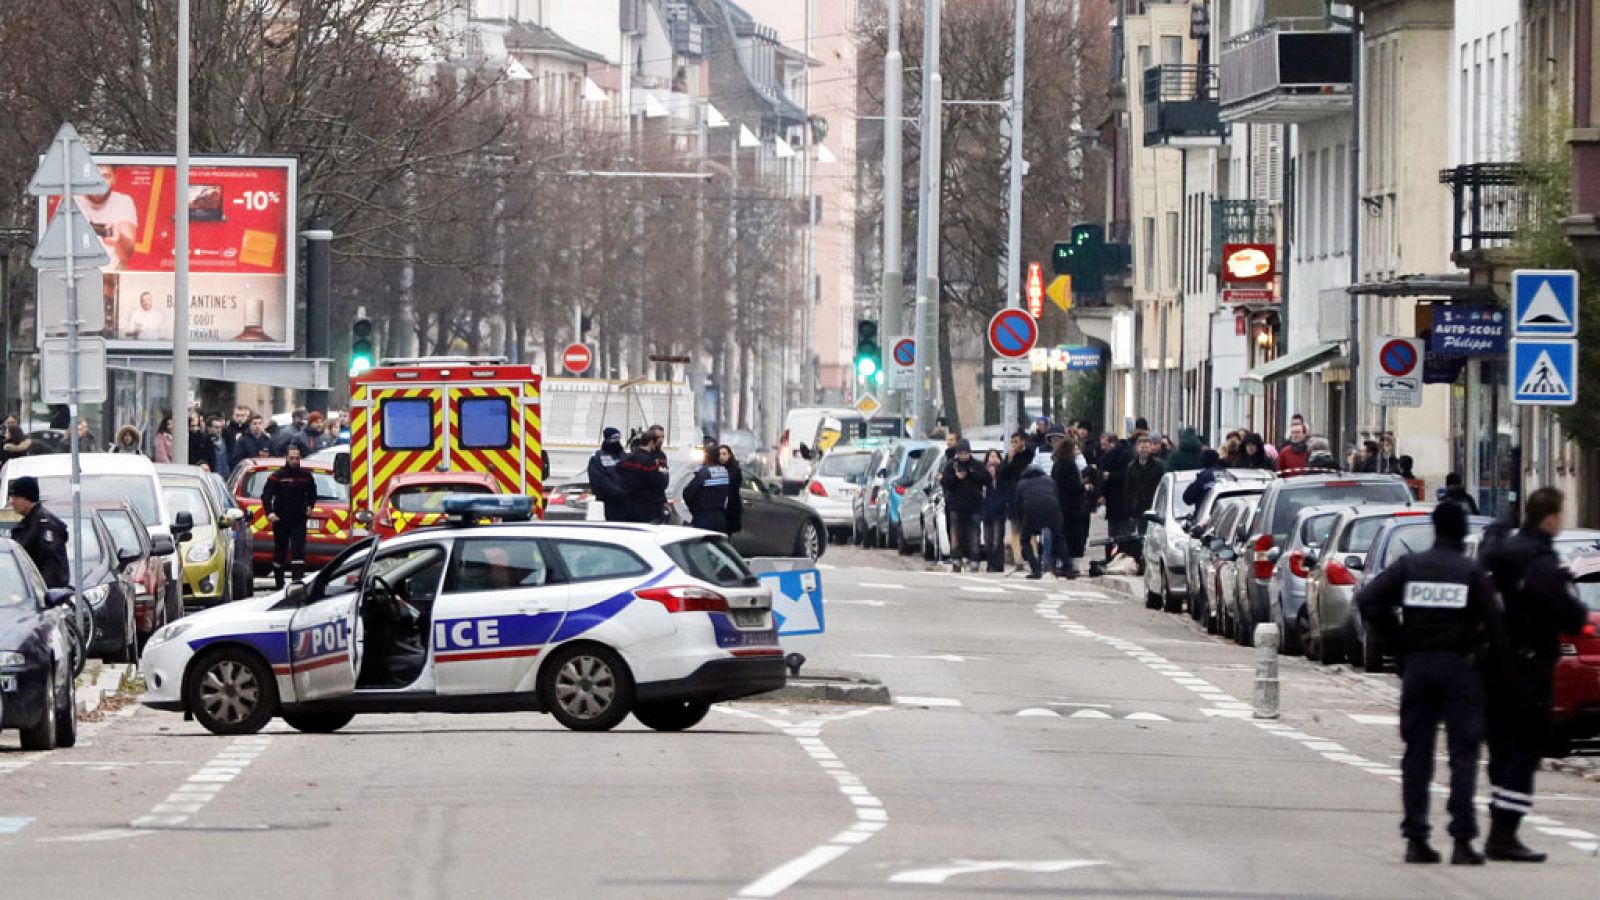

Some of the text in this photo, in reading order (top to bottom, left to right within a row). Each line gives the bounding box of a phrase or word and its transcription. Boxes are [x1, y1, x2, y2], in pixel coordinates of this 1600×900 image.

[233, 190, 280, 211] -10%
[167, 295, 237, 309] BANTINE'S
[1443, 335, 1493, 350] Philippe
[1411, 585, 1464, 601] POLICE
